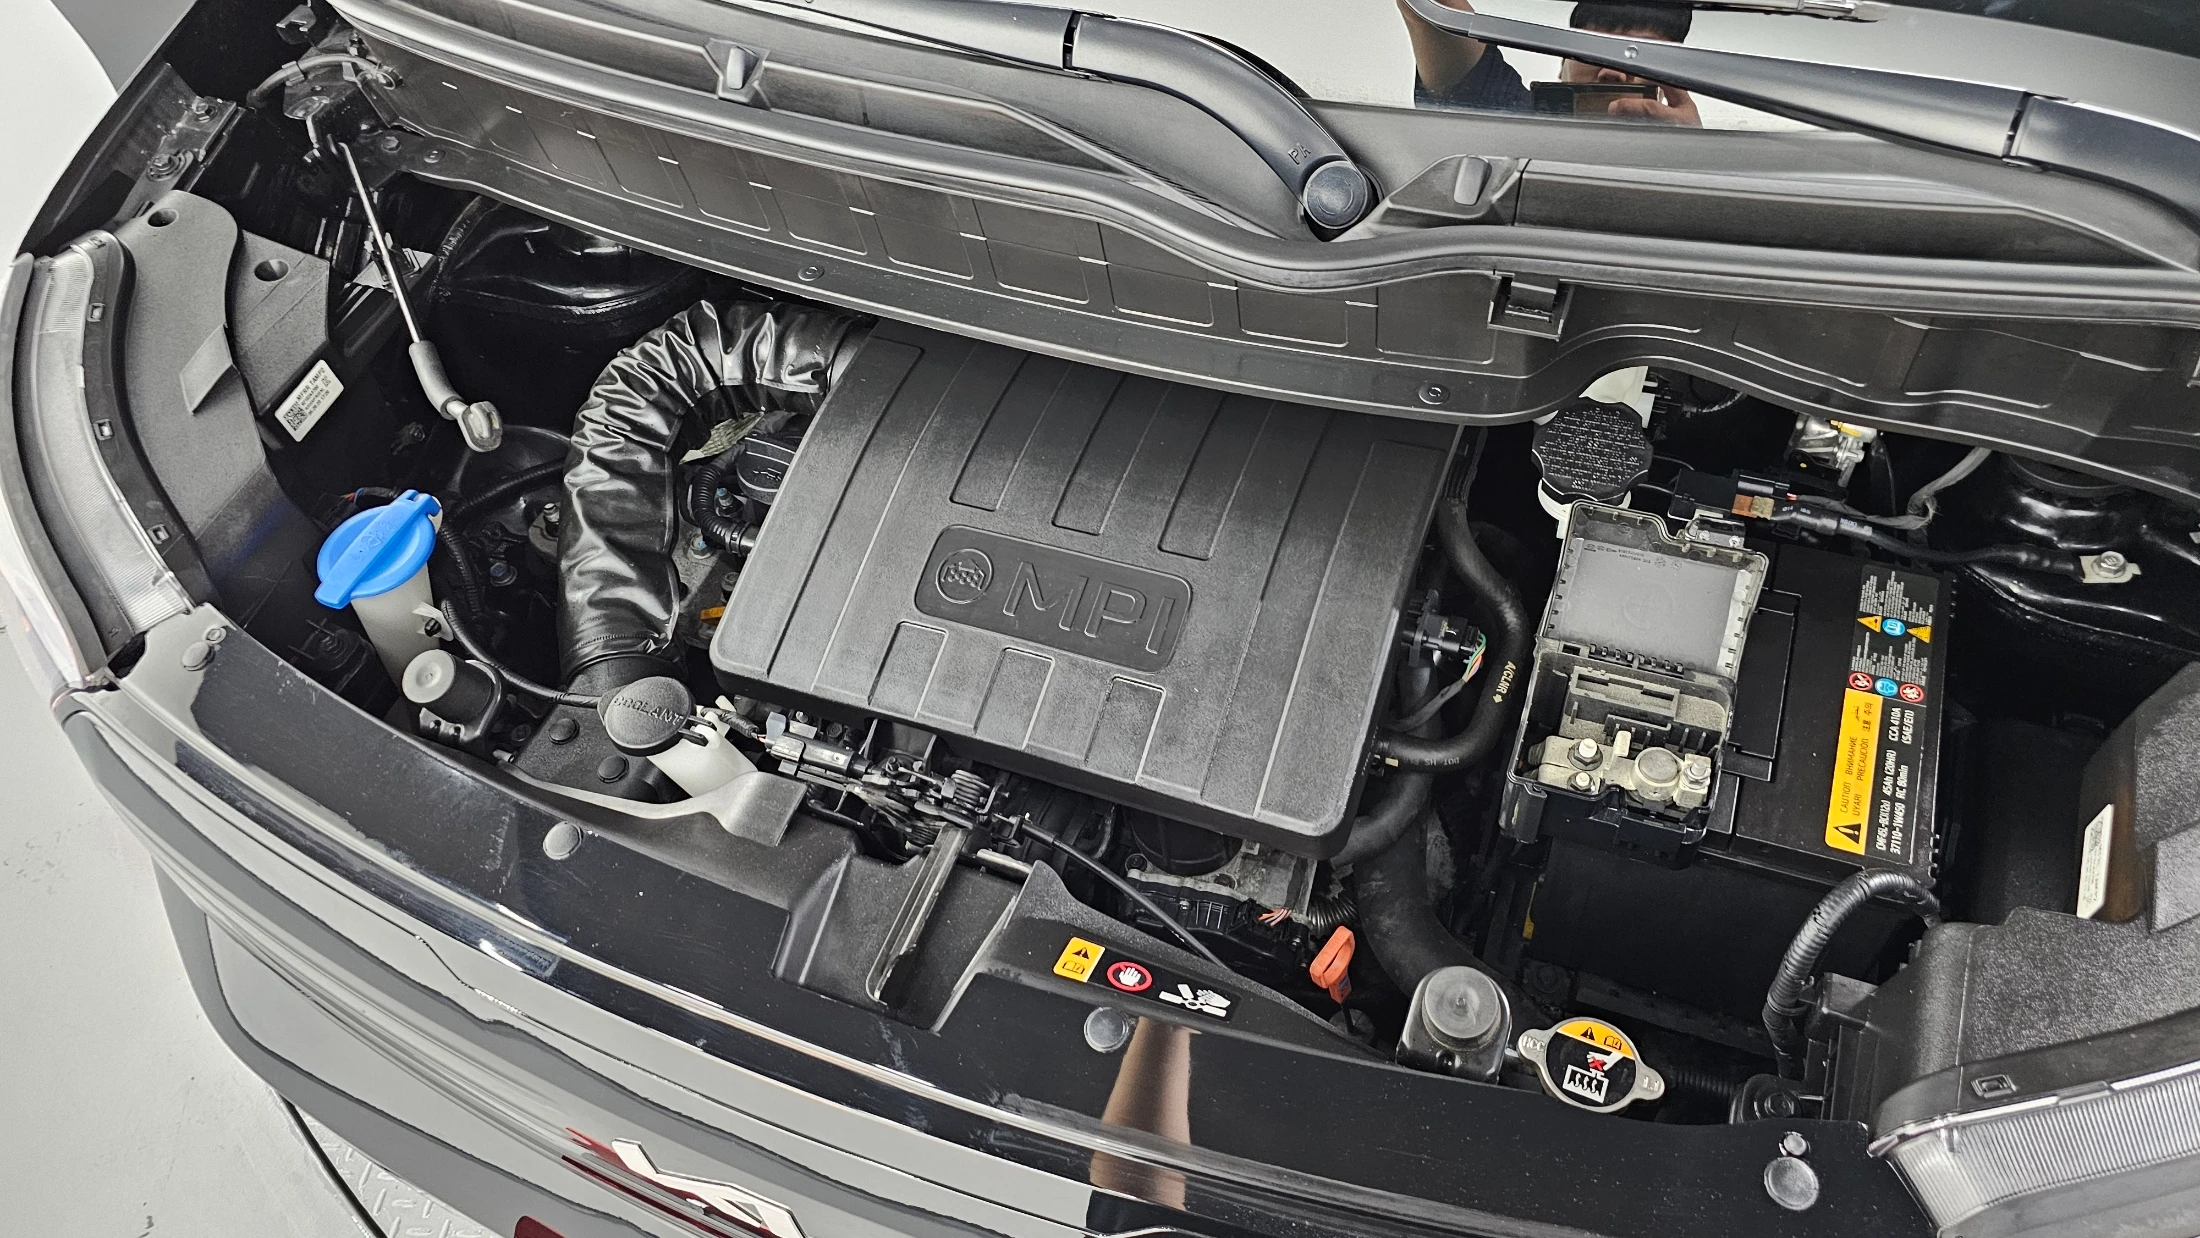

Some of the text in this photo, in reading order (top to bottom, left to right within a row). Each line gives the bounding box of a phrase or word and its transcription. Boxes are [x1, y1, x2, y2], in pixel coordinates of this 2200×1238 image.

[1003, 561, 1176, 654] MPI
[613, 696, 684, 725] COOLANT
[1863, 702, 1873, 716] 주의
[1890, 707, 1901, 725] 410A
[1888, 726, 1899, 741] CCA
[1846, 736, 1857, 775] ВНИМАНИЕ
[1884, 750, 1897, 776] (20HR)
[1883, 777, 1894, 796] 45Ah
[1897, 765, 1909, 787] 80min
[1840, 781, 1851, 813] CAUTION
[1895, 788, 1906, 799] RC
[1853, 795, 1862, 816] UYARI
[1890, 803, 1905, 855] 37110-1W450
